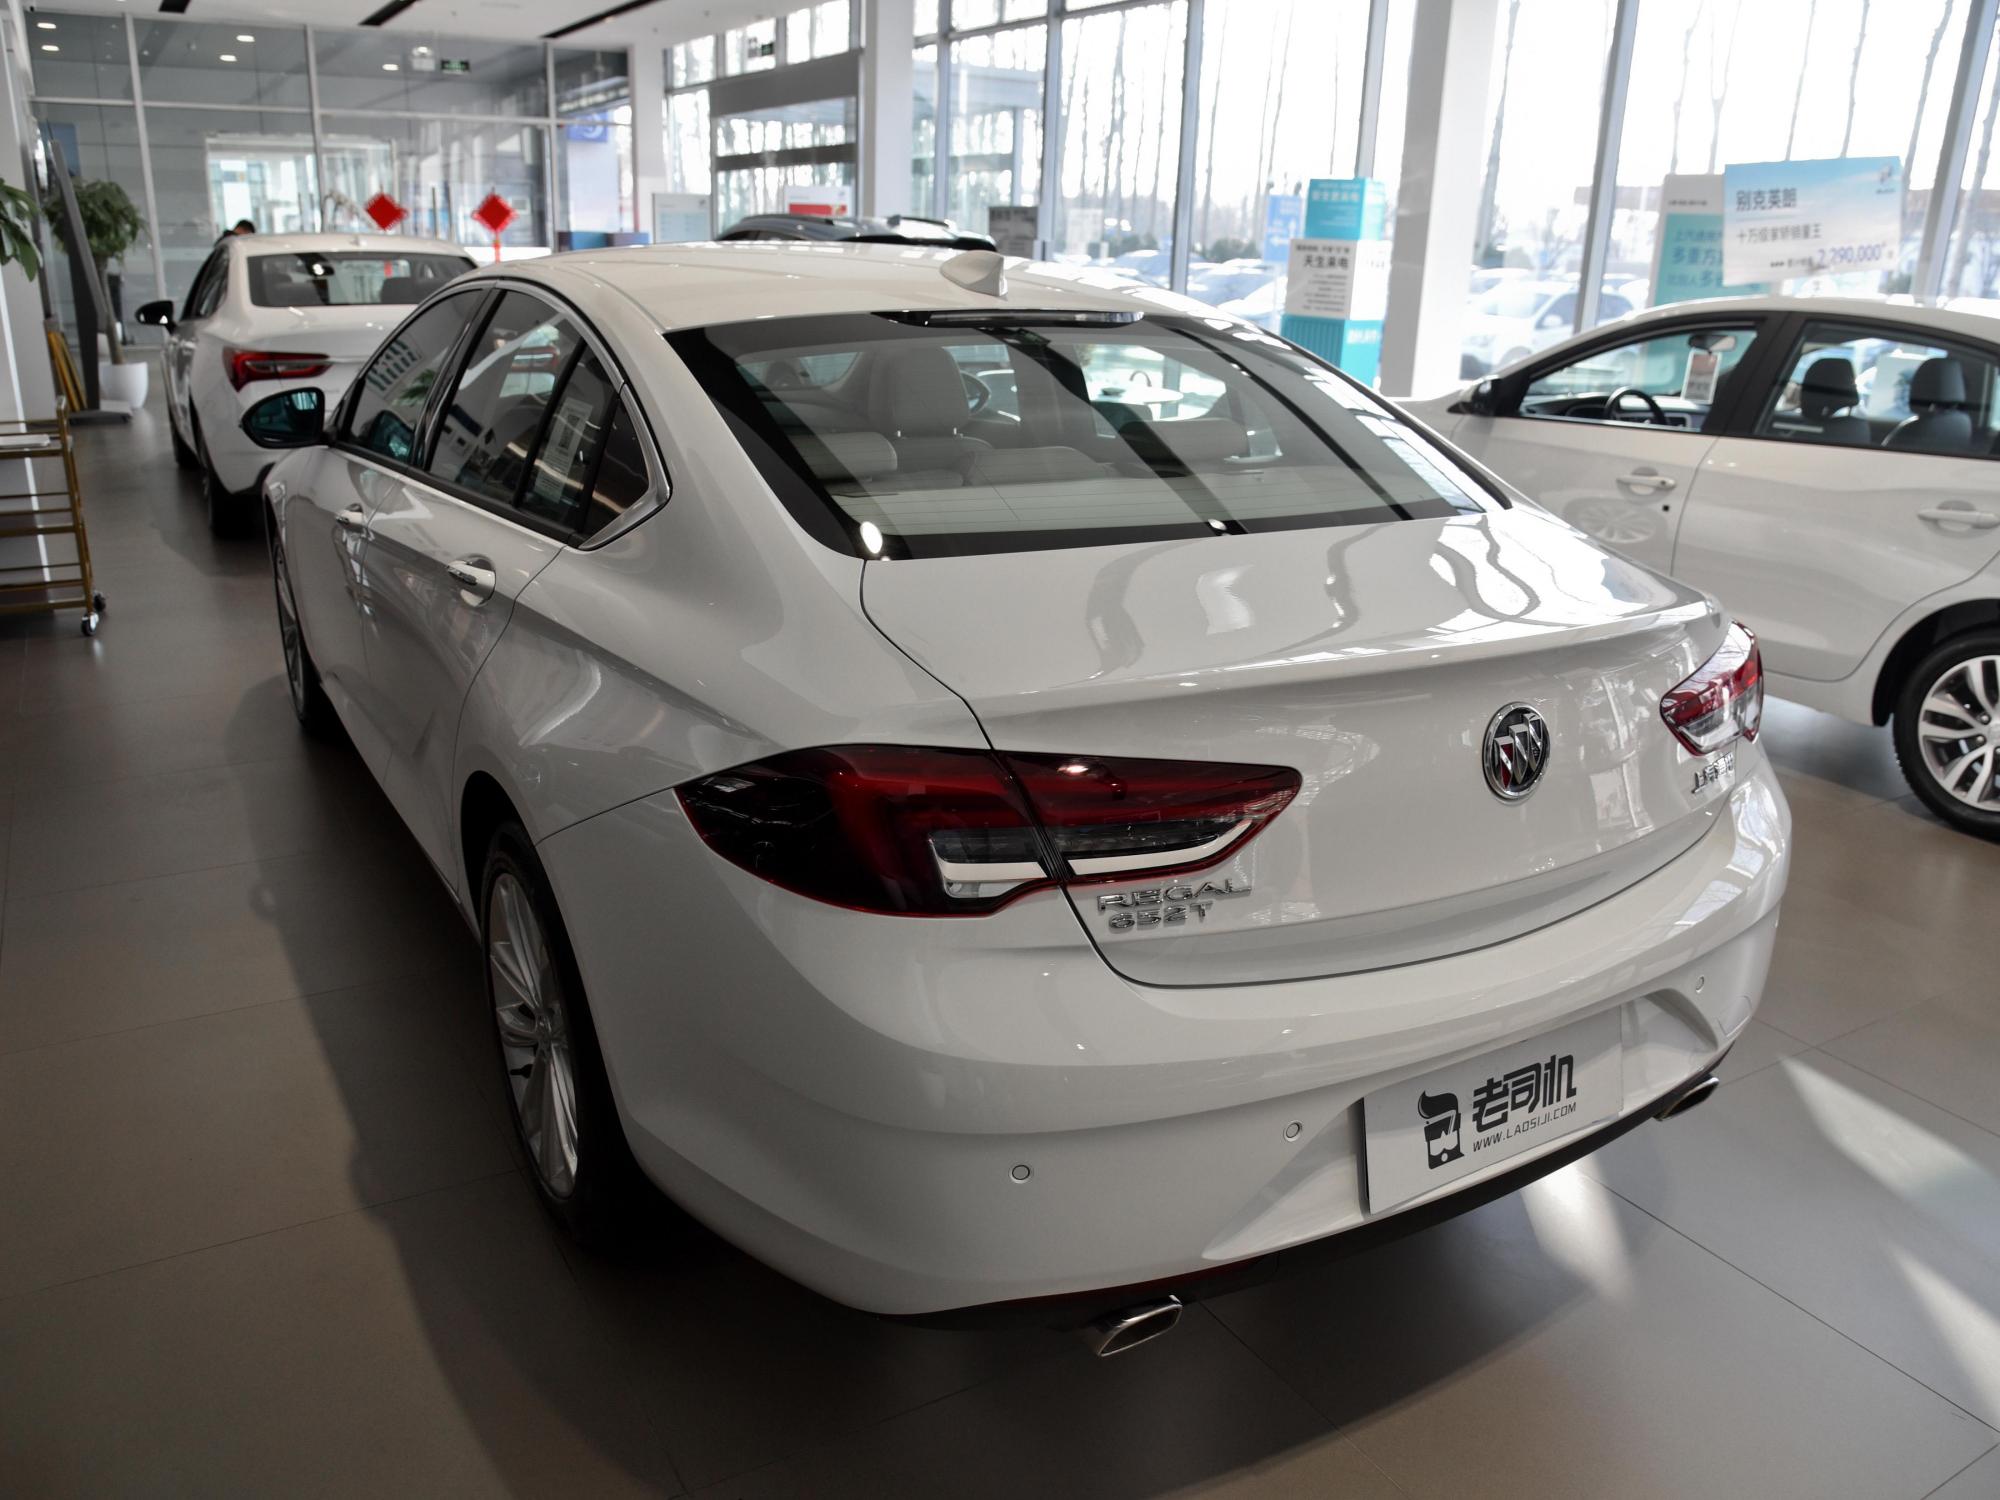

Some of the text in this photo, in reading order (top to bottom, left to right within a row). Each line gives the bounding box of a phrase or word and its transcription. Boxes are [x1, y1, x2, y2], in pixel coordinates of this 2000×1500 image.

[1736, 188, 1798, 211] 别克英朗
[1097, 878, 1252, 914] REGAL
[1109, 900, 1214, 931] 652T
[1472, 1054, 1577, 1133] 老司机
[1472, 1101, 1577, 1153] WWW.LAOSIJI.COM
